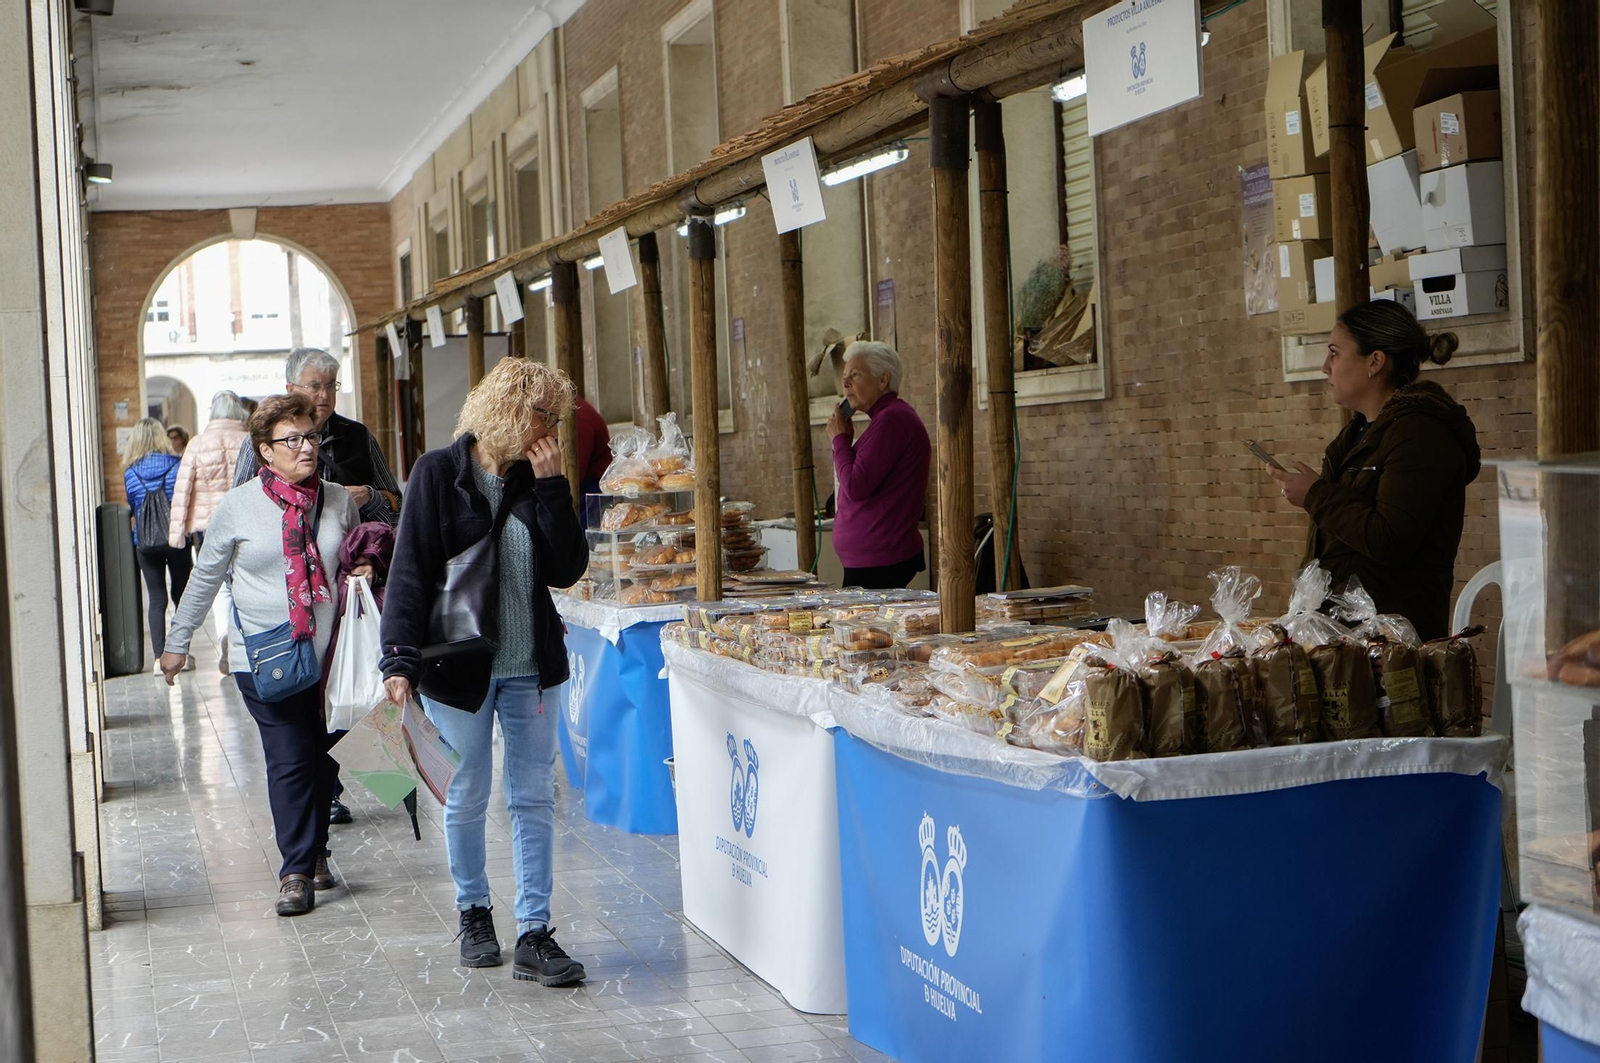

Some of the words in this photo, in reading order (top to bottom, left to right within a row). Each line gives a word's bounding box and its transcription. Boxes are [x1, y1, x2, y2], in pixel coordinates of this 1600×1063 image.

[1107, 8, 1131, 28] PRODUCTOS
[1429, 293, 1452, 306] VILLA
[743, 850, 768, 878] PROVINCIAL
[900, 945, 940, 987] DIPUTACIÓN
[940, 969, 983, 1014] PROVINCIAL
[930, 987, 957, 1022] HUELVA
